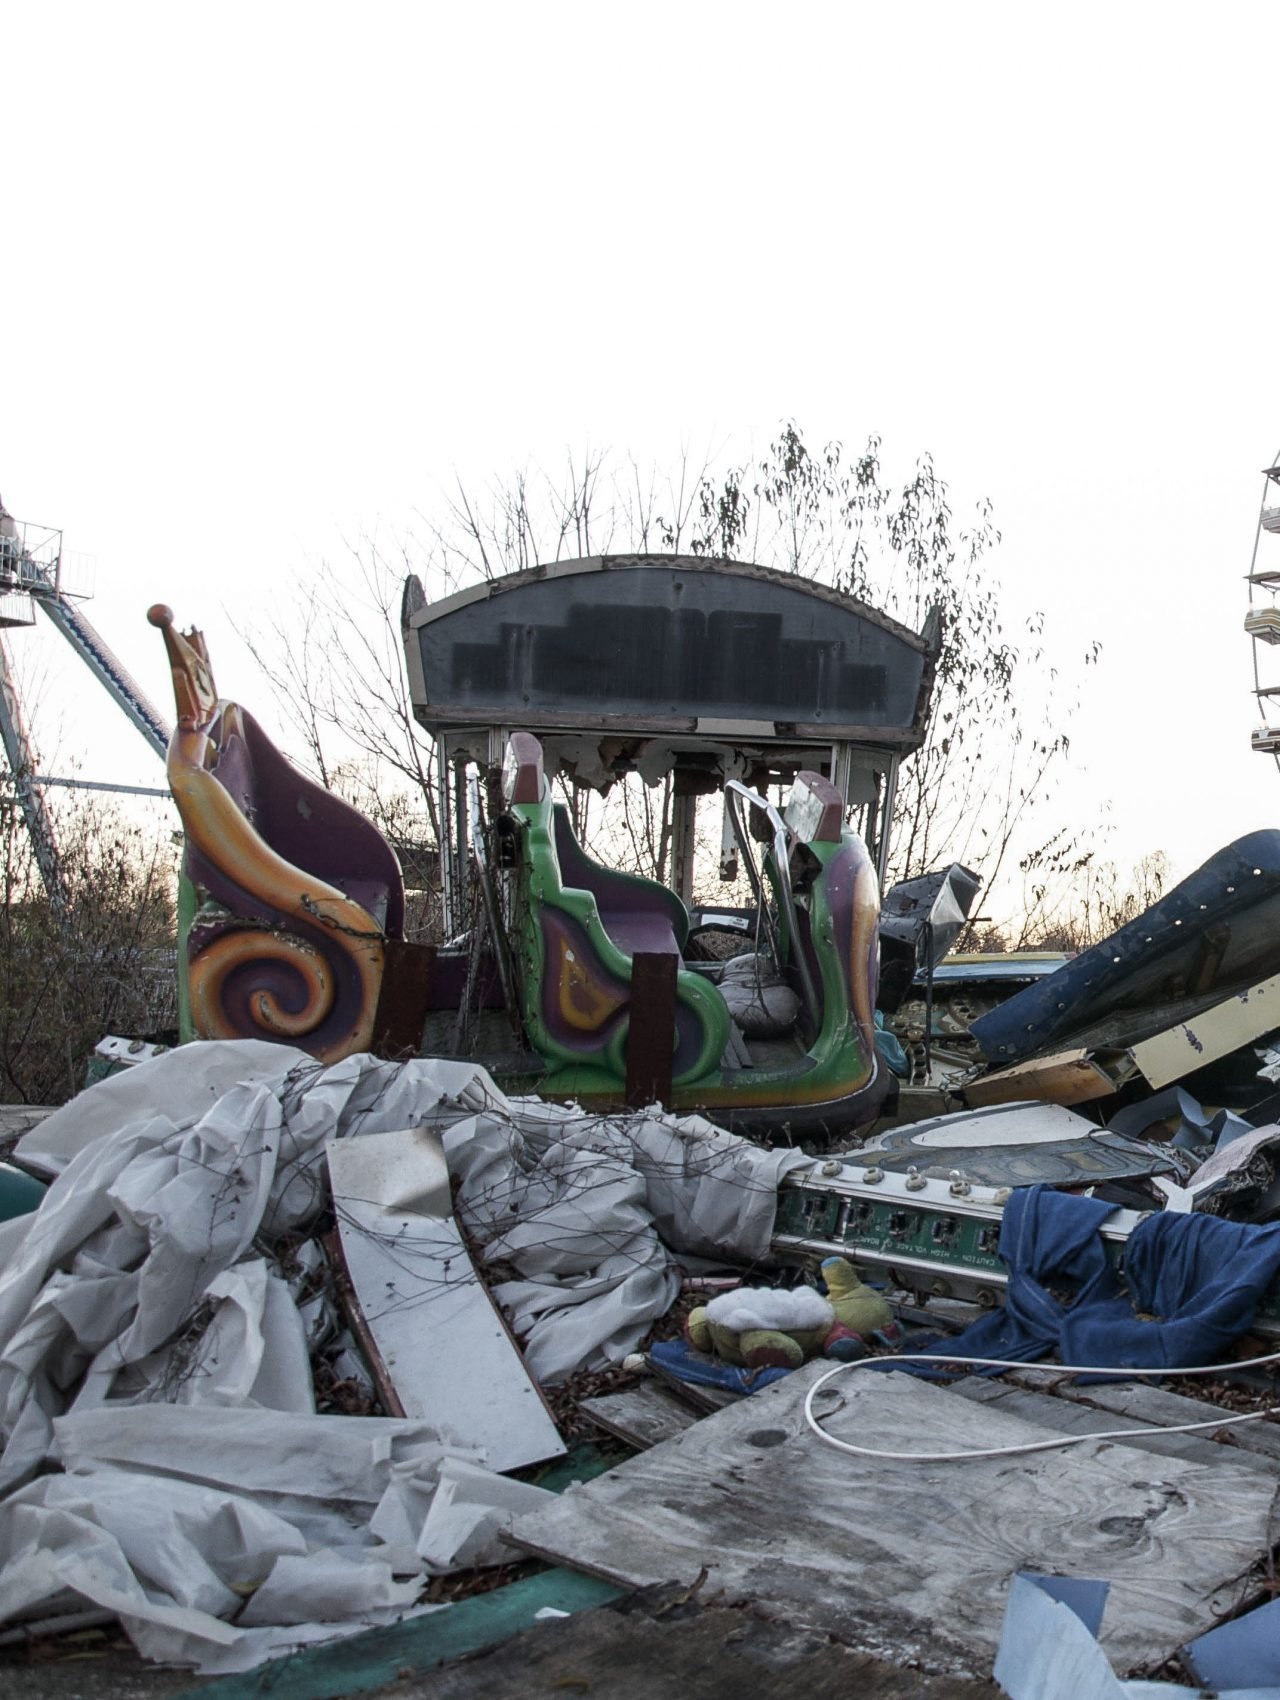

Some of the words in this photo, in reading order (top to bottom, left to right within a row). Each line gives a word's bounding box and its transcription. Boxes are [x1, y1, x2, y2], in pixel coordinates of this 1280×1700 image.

[896, 1241, 928, 1255] VOLTAGE
[930, 1249, 950, 1258] HIGH
[962, 1253, 996, 1267] CAUTION
